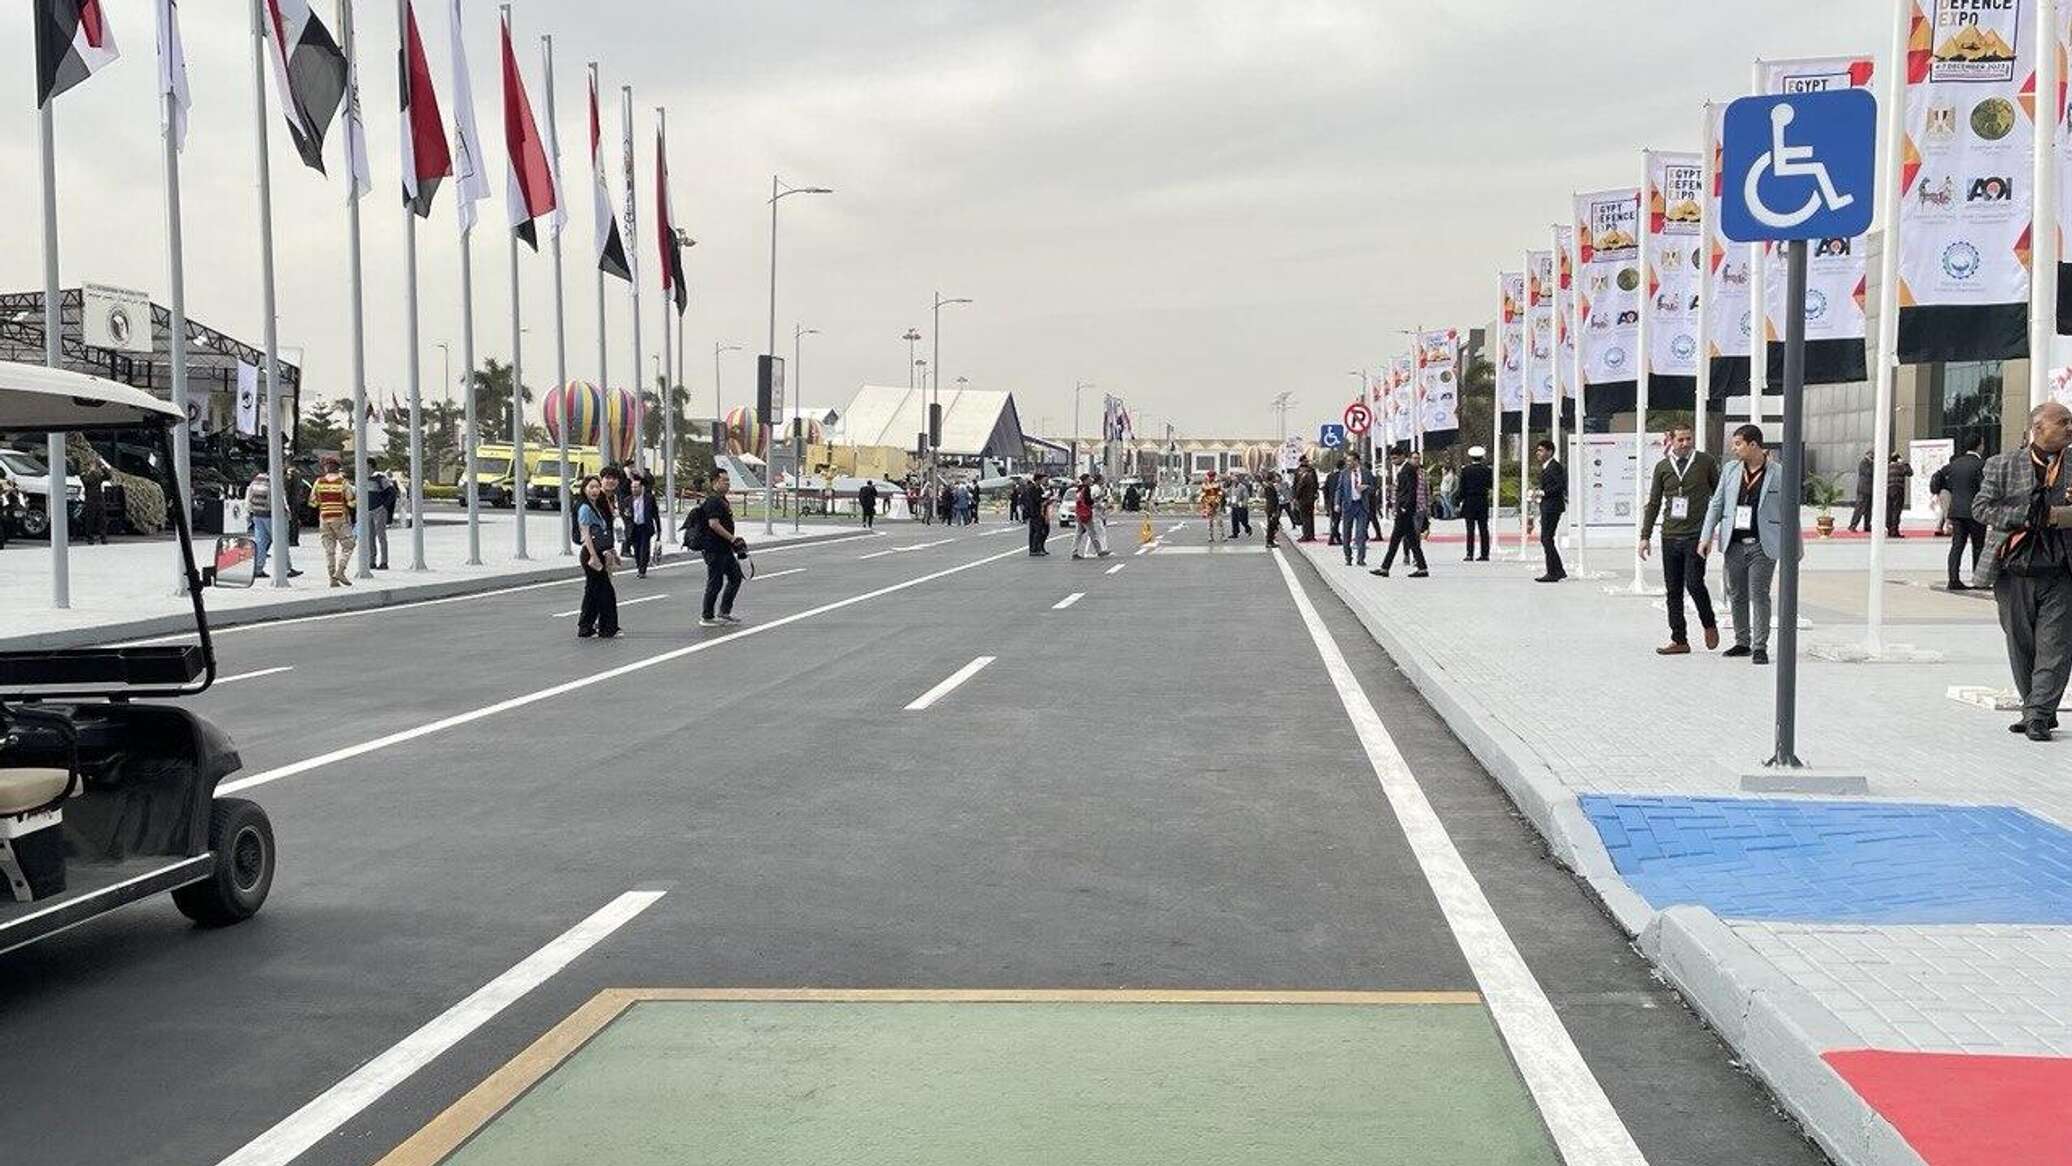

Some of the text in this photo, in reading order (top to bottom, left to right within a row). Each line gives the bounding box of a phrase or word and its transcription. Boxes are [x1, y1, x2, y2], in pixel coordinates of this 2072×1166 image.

[1940, 0, 2012, 10] DEFENCE
[1939, 11, 1979, 26] EXPO
[1788, 79, 1829, 92] EGYPT
[1669, 179, 1702, 190] DEFEN
[1966, 176, 2013, 201] AOI
[1617, 310, 1639, 325] AO
